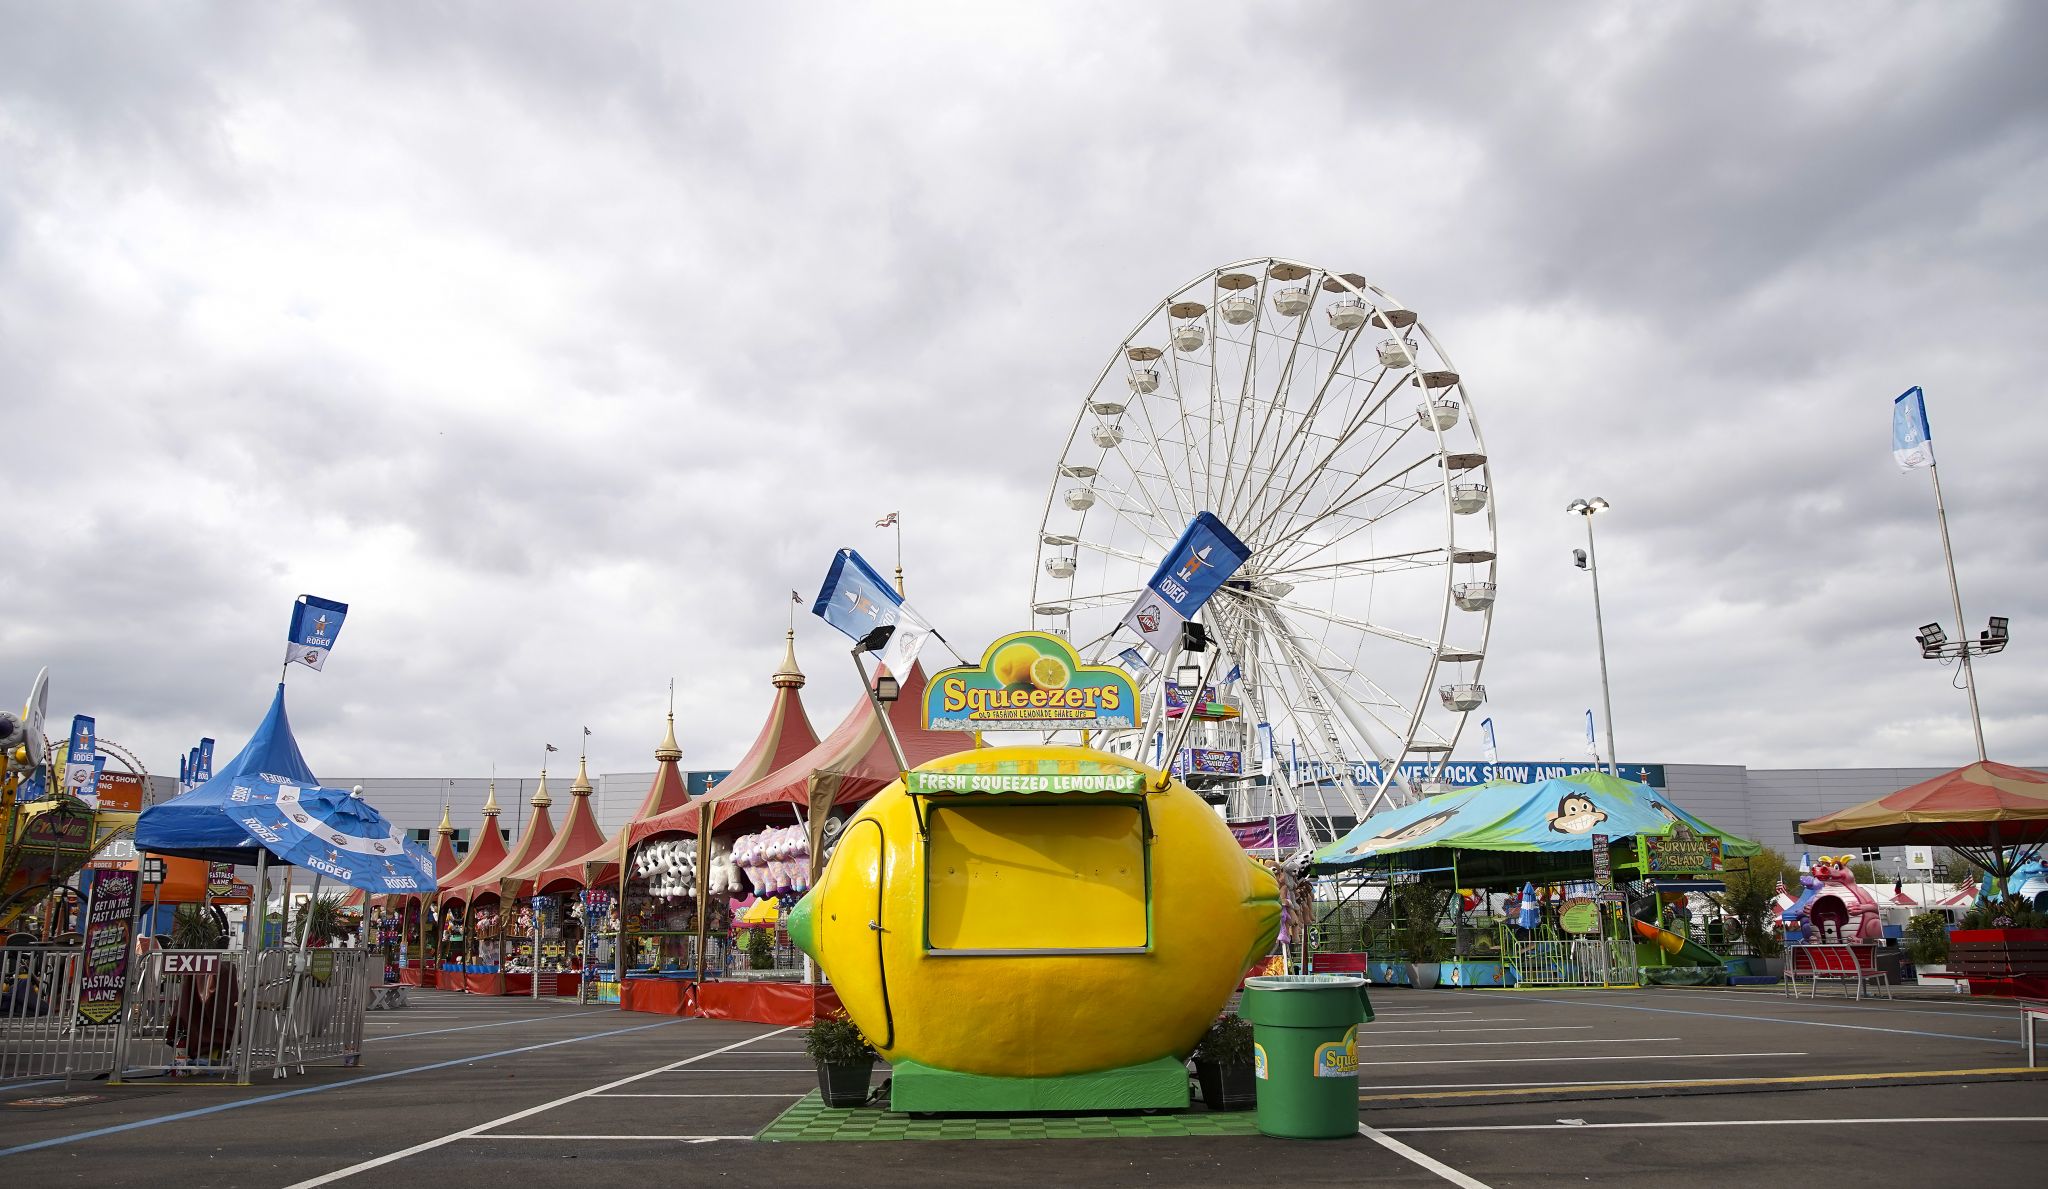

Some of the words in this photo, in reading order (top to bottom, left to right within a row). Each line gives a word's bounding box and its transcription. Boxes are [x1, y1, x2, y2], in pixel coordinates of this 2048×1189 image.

[306, 637, 330, 647] RODEO
[944, 678, 1120, 713] Squeezers
[992, 710, 1018, 719] FASHION
[1020, 709, 1051, 718] LEMONADE
[1054, 710, 1073, 718] SHAKE
[1075, 710, 1087, 718] UPS
[115, 776, 137, 784] SHOW
[1484, 766, 1529, 783] SHOW
[1535, 766, 1564, 783] AND
[919, 774, 966, 790] FRESH
[972, 775, 1048, 791] SQUEEZED
[1053, 774, 1135, 790] LEMONADE
[243, 818, 280, 843] RODEO
[1656, 841, 1711, 852] SURVIVAL
[1666, 855, 1705, 866] ISLAND
[307, 857, 351, 880] RODEO
[209, 872, 234, 880] FASTPASS
[384, 878, 417, 889] RODEO
[95, 900, 108, 912] GET
[108, 899, 115, 909] IN
[117, 898, 130, 908] THE
[91, 911, 109, 923] FAST
[110, 908, 132, 920] LANE!
[164, 955, 218, 972] EXIT
[82, 975, 125, 989] FASTPASS
[88, 990, 117, 1002] LANE
